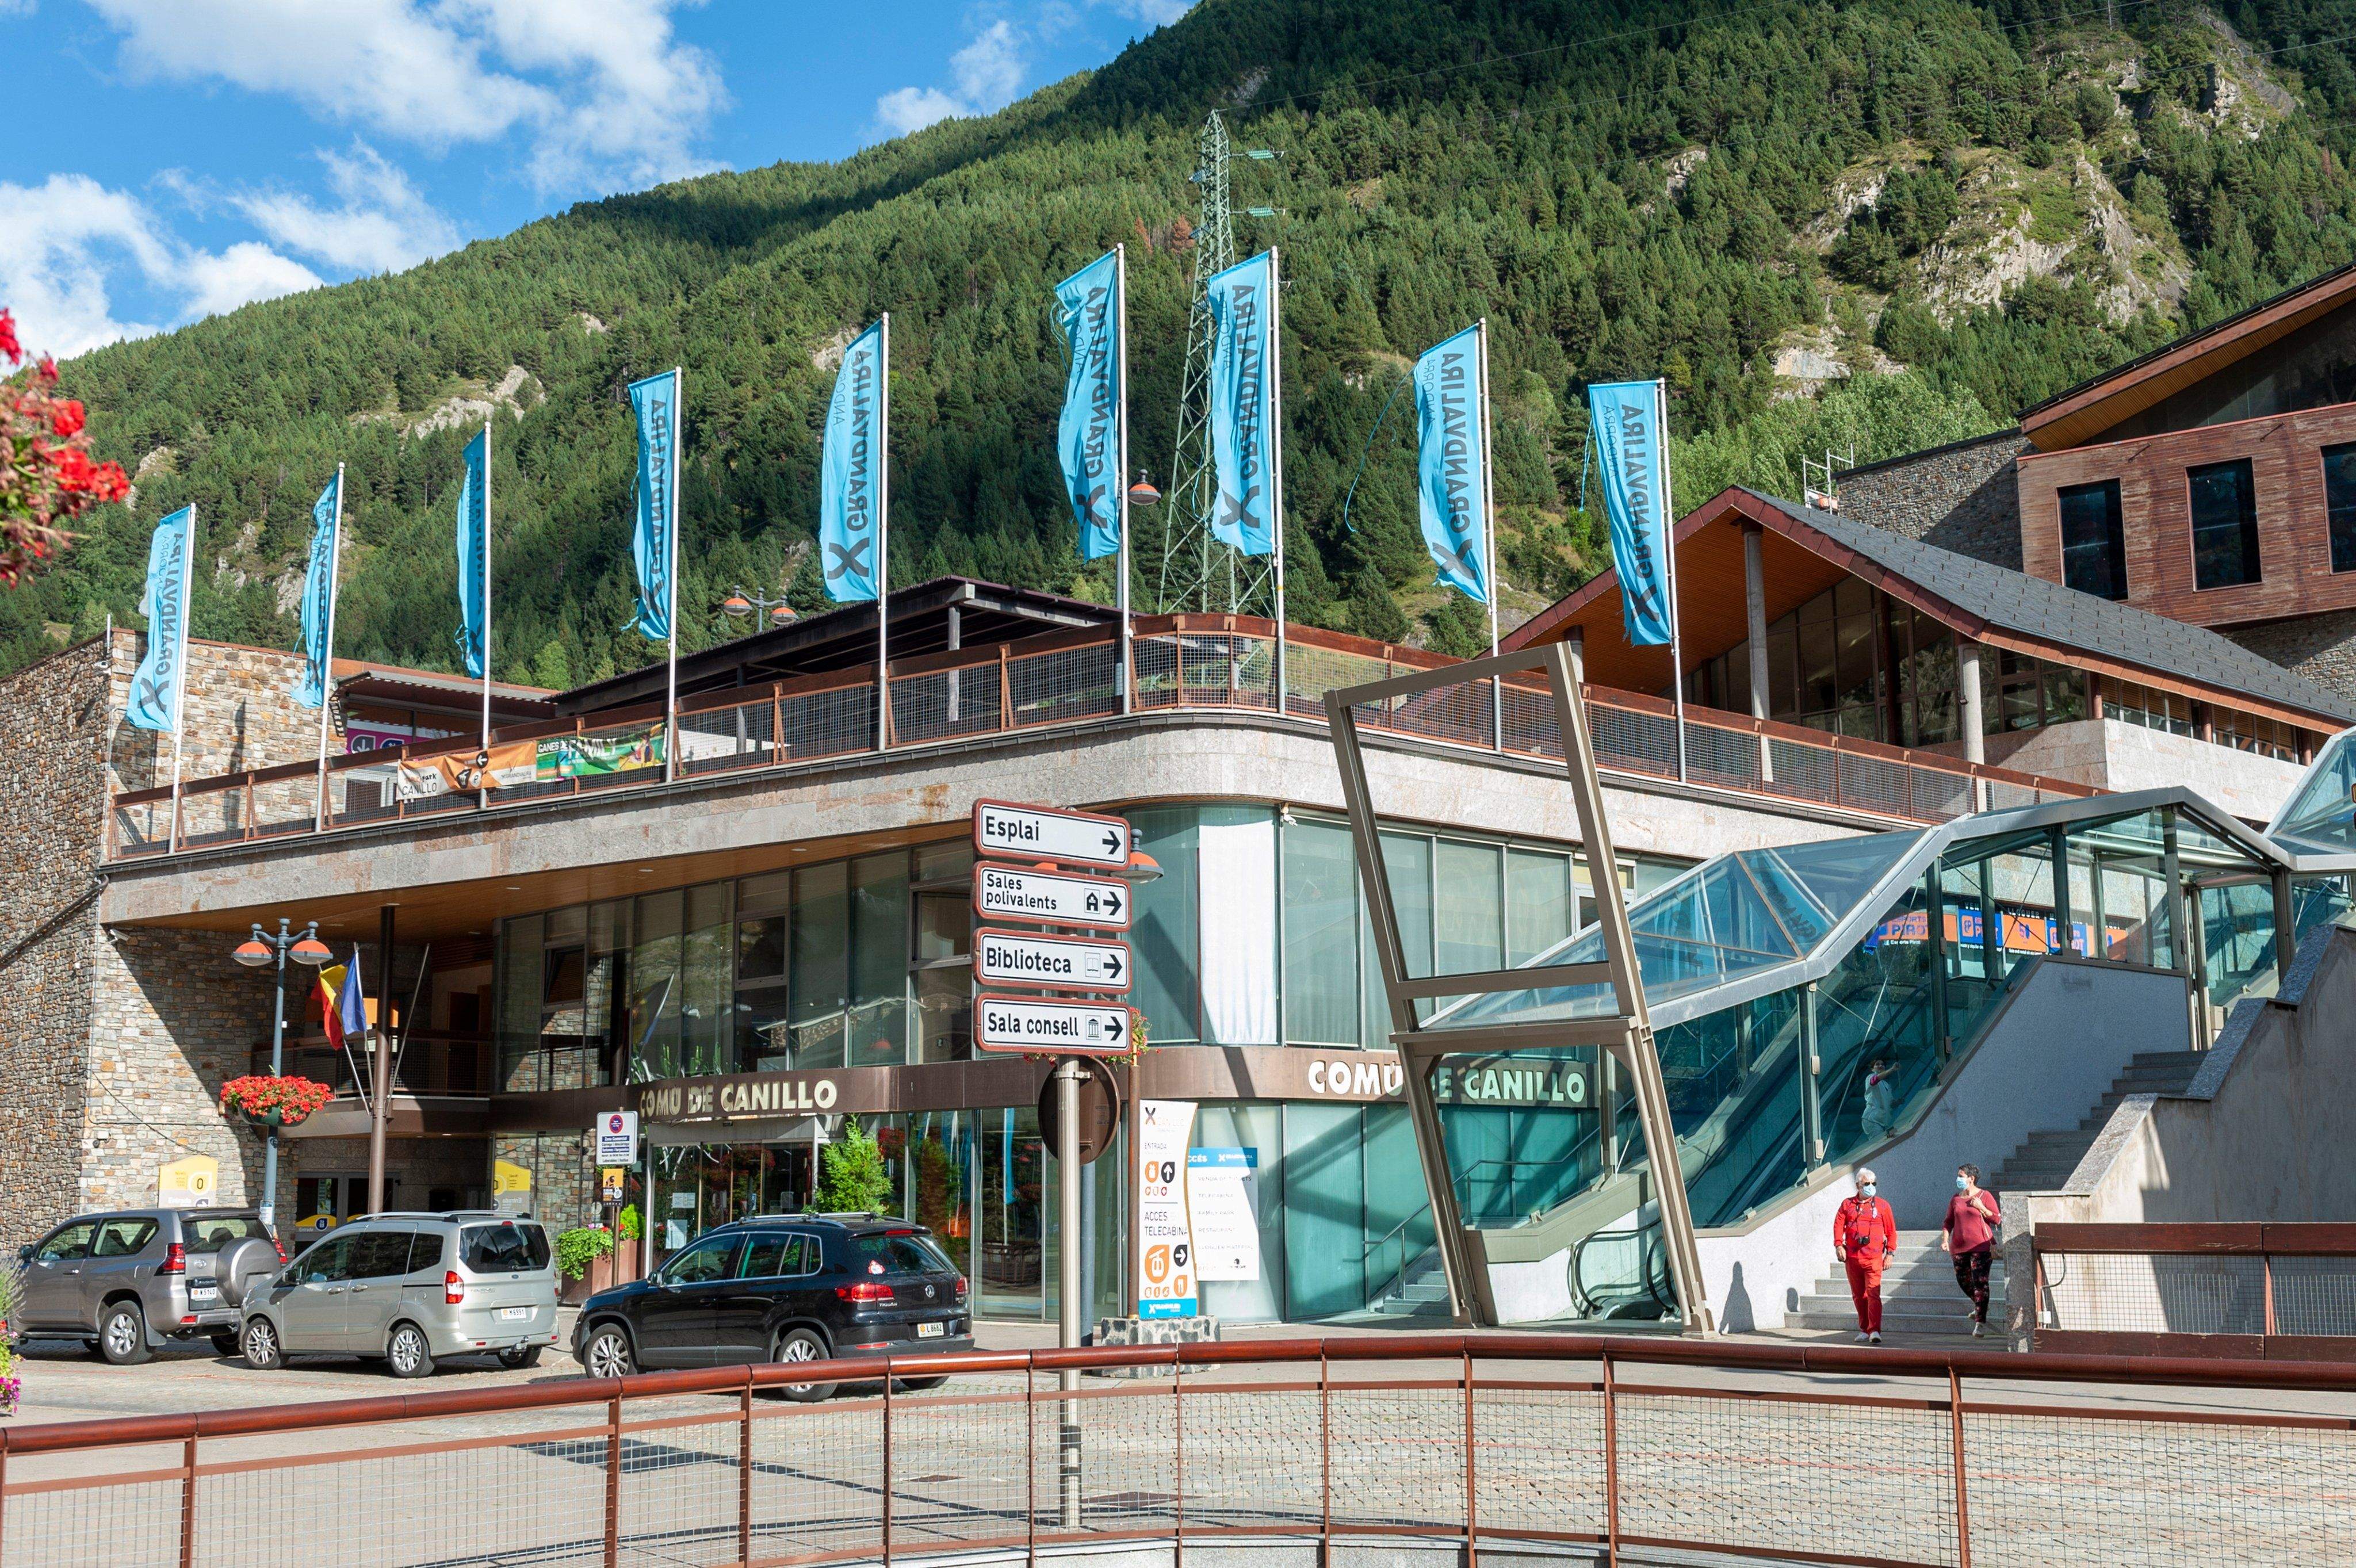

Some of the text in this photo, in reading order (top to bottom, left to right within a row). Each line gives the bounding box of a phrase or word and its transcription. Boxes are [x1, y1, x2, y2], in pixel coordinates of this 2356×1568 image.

[538, 741, 560, 753] GANES
[986, 815, 1039, 842] Esplai
[986, 874, 1023, 890] Sales
[986, 891, 1057, 911] polivalents
[986, 947, 1072, 974] Biblioteca
[988, 1012, 1079, 1037] Sala consell
[687, 1084, 714, 1114] DE
[720, 1080, 837, 1112] CANILLO
[1430, 1067, 1453, 1097] E
[1464, 1068, 1586, 1103] CANILLO
[1144, 1226, 1188, 1236] TELECABINA
